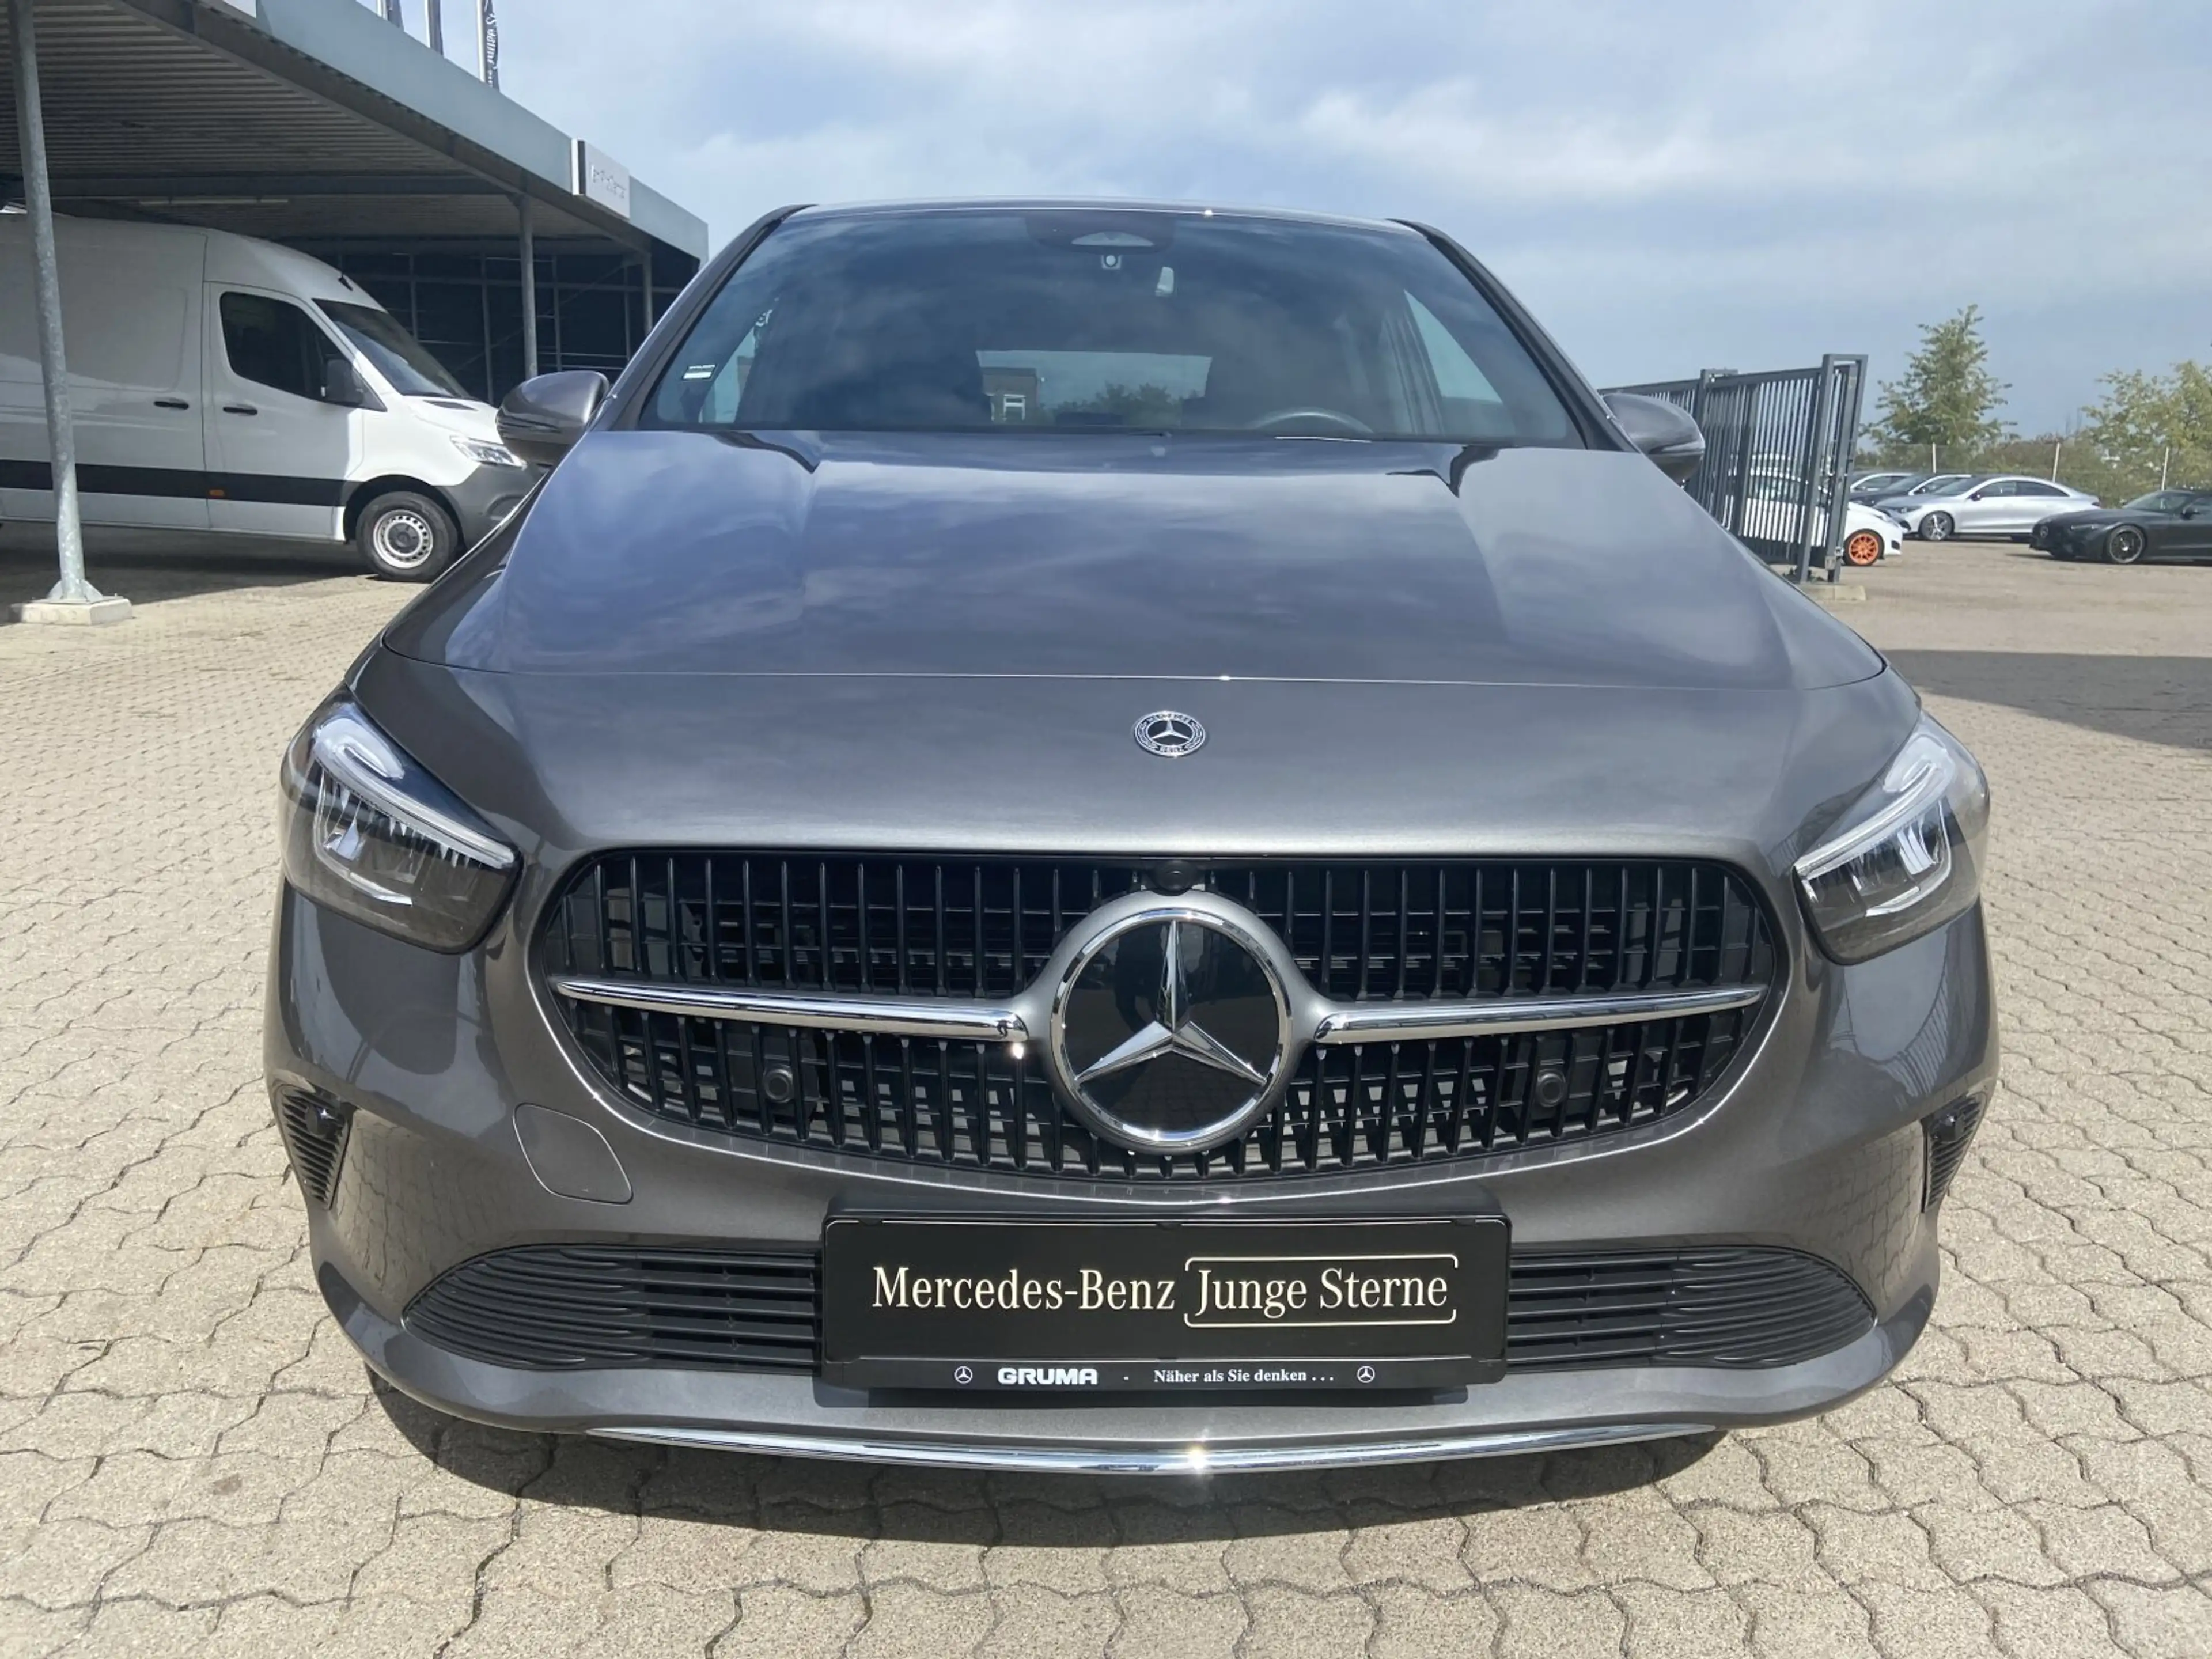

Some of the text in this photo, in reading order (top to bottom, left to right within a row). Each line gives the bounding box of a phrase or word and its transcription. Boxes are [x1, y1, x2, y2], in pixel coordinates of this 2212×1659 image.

[872, 1266, 1449, 1318] Mercedes-Benz Junge Sterne
[997, 1368, 1099, 1385] GRUMA
[1153, 1369, 1200, 1383] Näher
[1203, 1369, 1224, 1382] als
[1227, 1369, 1251, 1382] Sie
[1253, 1368, 1307, 1382] denken
